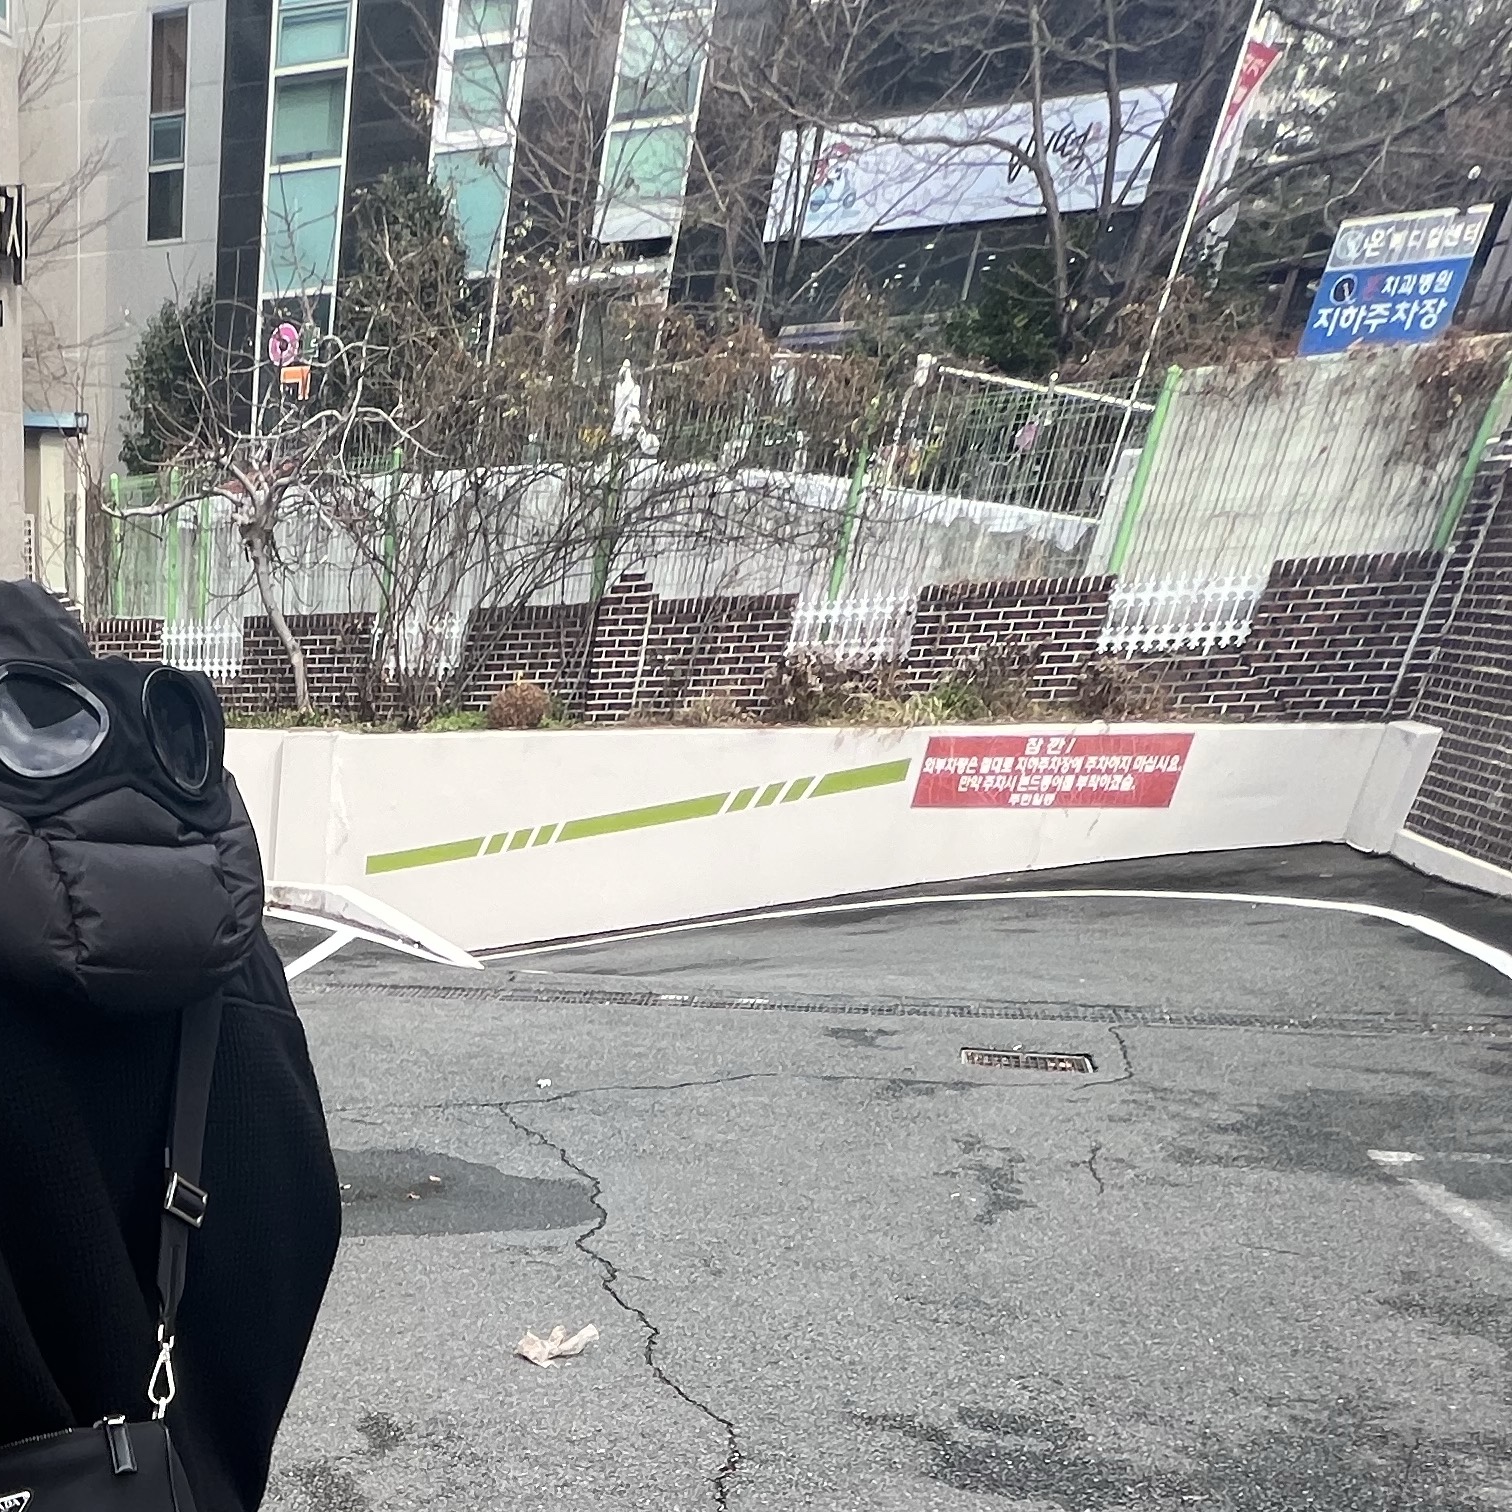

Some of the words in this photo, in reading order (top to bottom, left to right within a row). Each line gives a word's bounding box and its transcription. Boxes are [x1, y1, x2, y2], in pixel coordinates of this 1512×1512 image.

[1381, 269, 1455, 298] 치과병원
[1312, 298, 1449, 337] 지하주차장
[922, 756, 979, 774] 외부차량은
